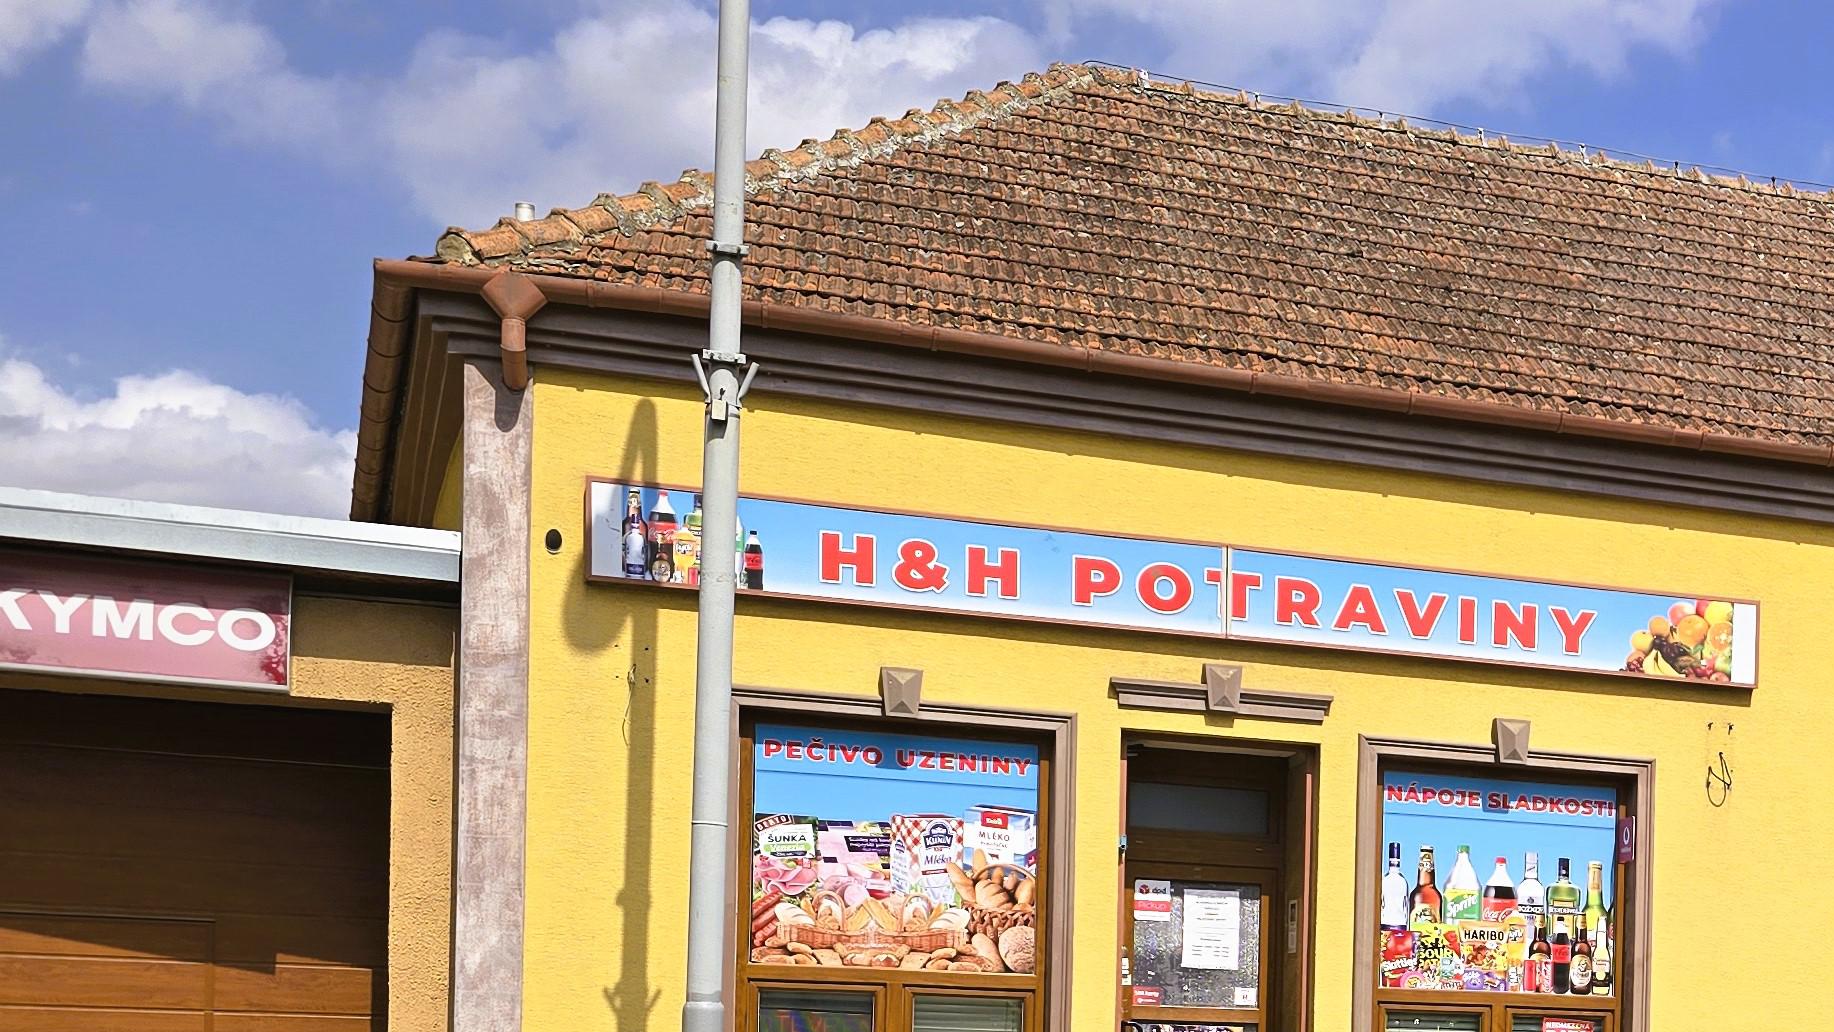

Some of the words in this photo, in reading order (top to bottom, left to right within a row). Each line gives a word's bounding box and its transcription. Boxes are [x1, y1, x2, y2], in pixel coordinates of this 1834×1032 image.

[819, 530, 1020, 599] H&H
[1071, 554, 1599, 656] POTRAVINY
[0, 587, 276, 652] KYMCO
[763, 738, 884, 766] PEČIVO
[895, 750, 1031, 777] UZENINY
[1386, 782, 1481, 808] NÁPOJE
[1487, 792, 1614, 817] SLADKOSTI
[768, 834, 807, 843] ŠUNKA
[978, 831, 1010, 842] MLÉKO
[1152, 886, 1167, 896] dpd
[1447, 894, 1477, 918] Sprite
[1464, 929, 1505, 941] HARIBO
